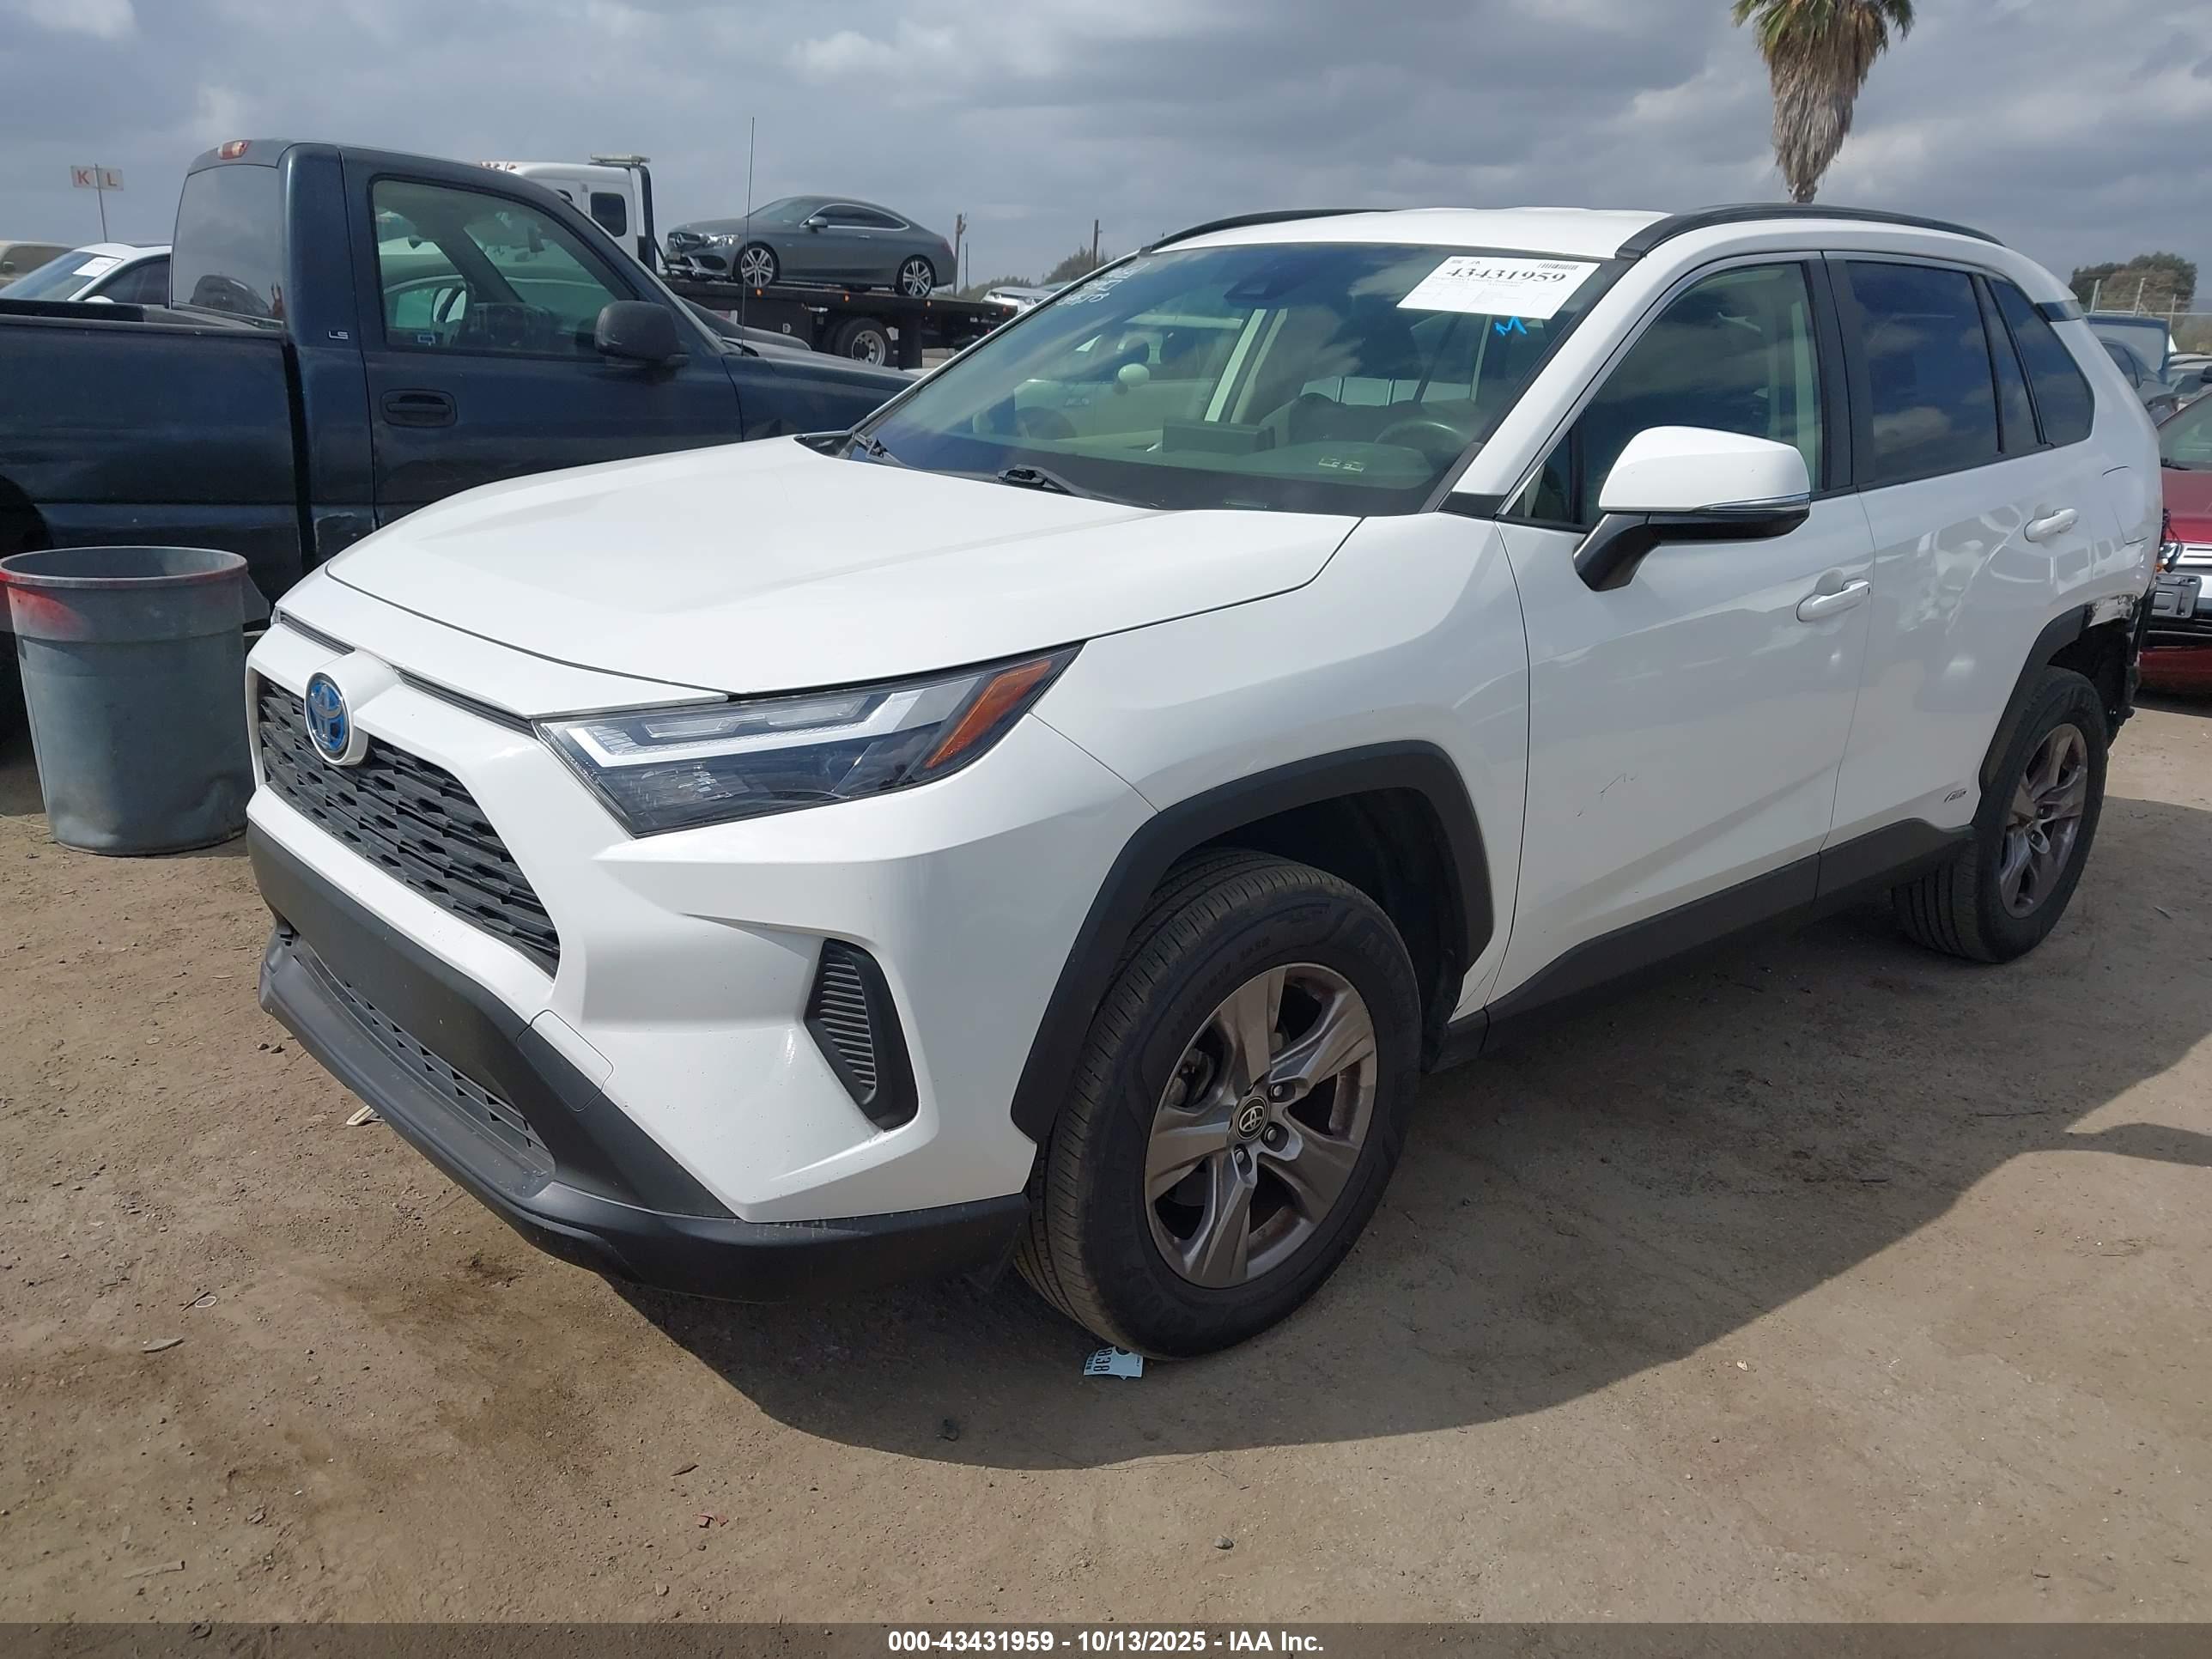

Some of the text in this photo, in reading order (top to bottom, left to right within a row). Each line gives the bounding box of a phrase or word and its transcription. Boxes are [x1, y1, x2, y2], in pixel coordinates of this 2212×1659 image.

[76, 170, 118, 186] K L
[1447, 268, 1566, 283] 43431959
[328, 331, 349, 340] LS
